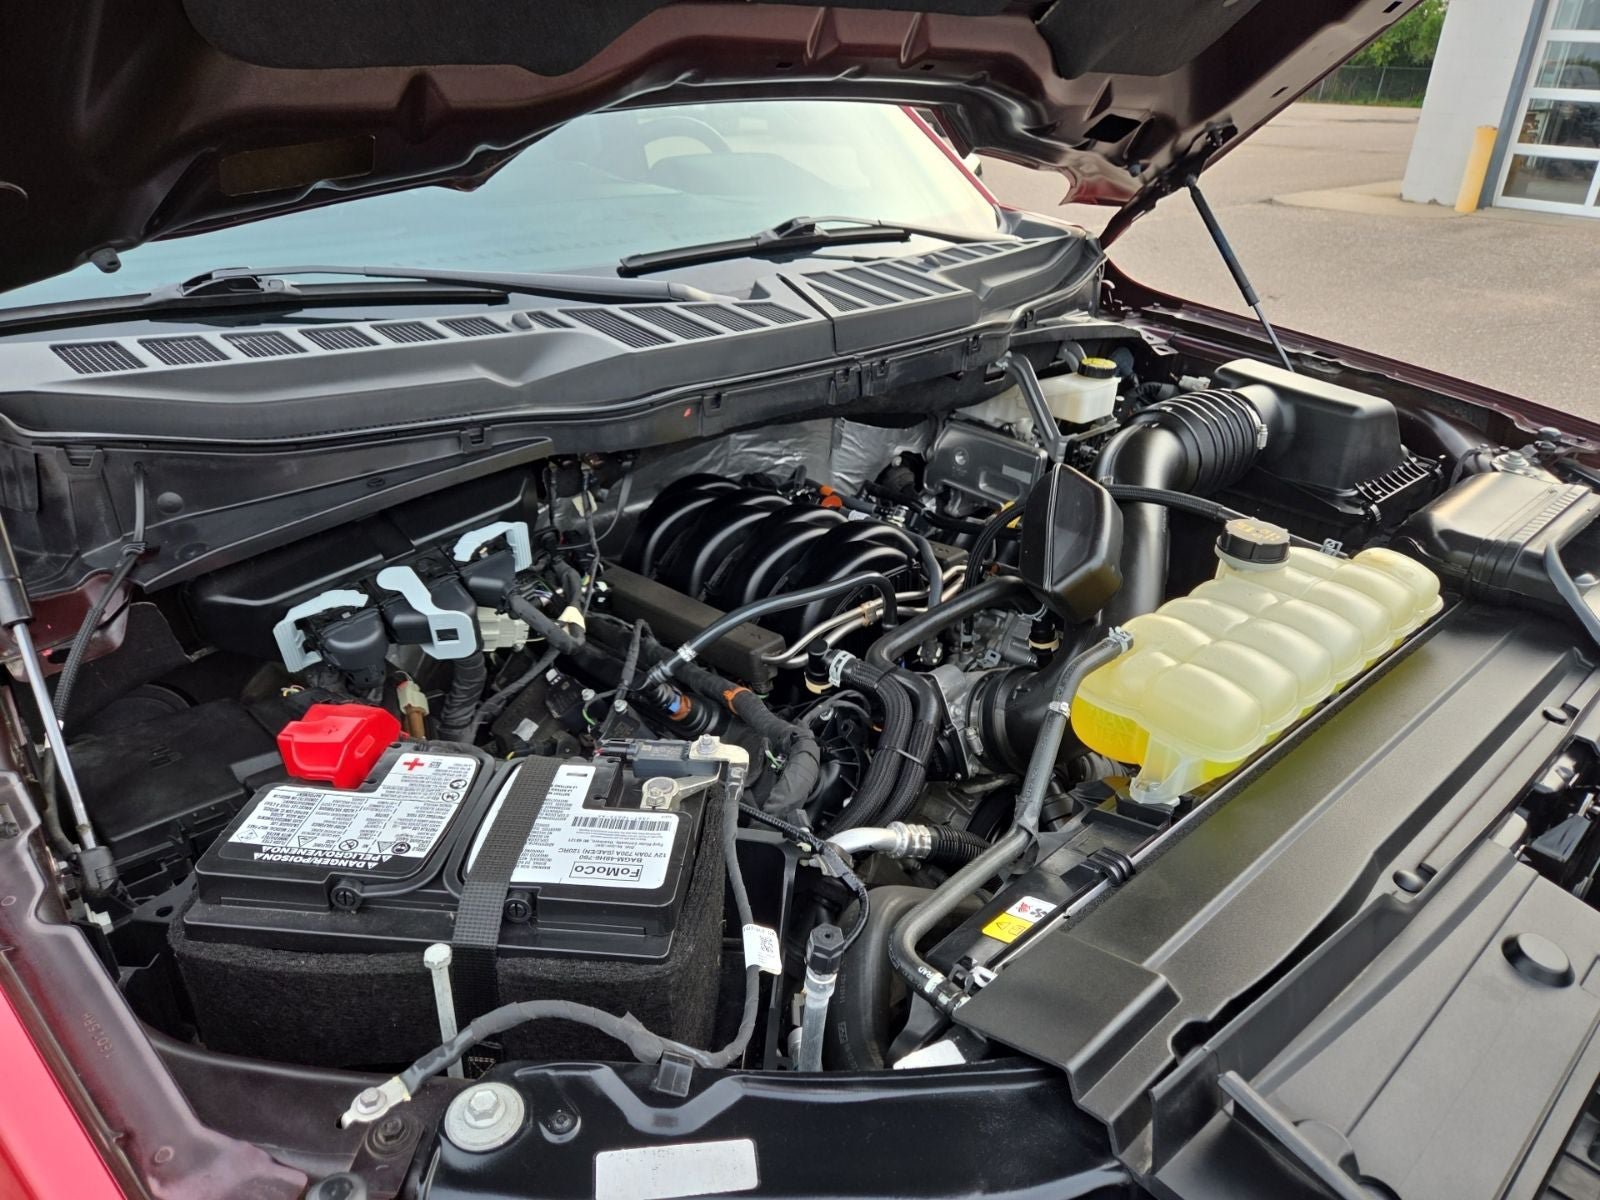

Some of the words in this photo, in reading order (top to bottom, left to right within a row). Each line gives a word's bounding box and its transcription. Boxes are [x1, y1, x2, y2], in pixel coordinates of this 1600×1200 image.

[262, 853, 366, 868] DANGER/POISON
[269, 847, 381, 861] PELIGRO/VENENO
[574, 865, 640, 877] FoMoCo
